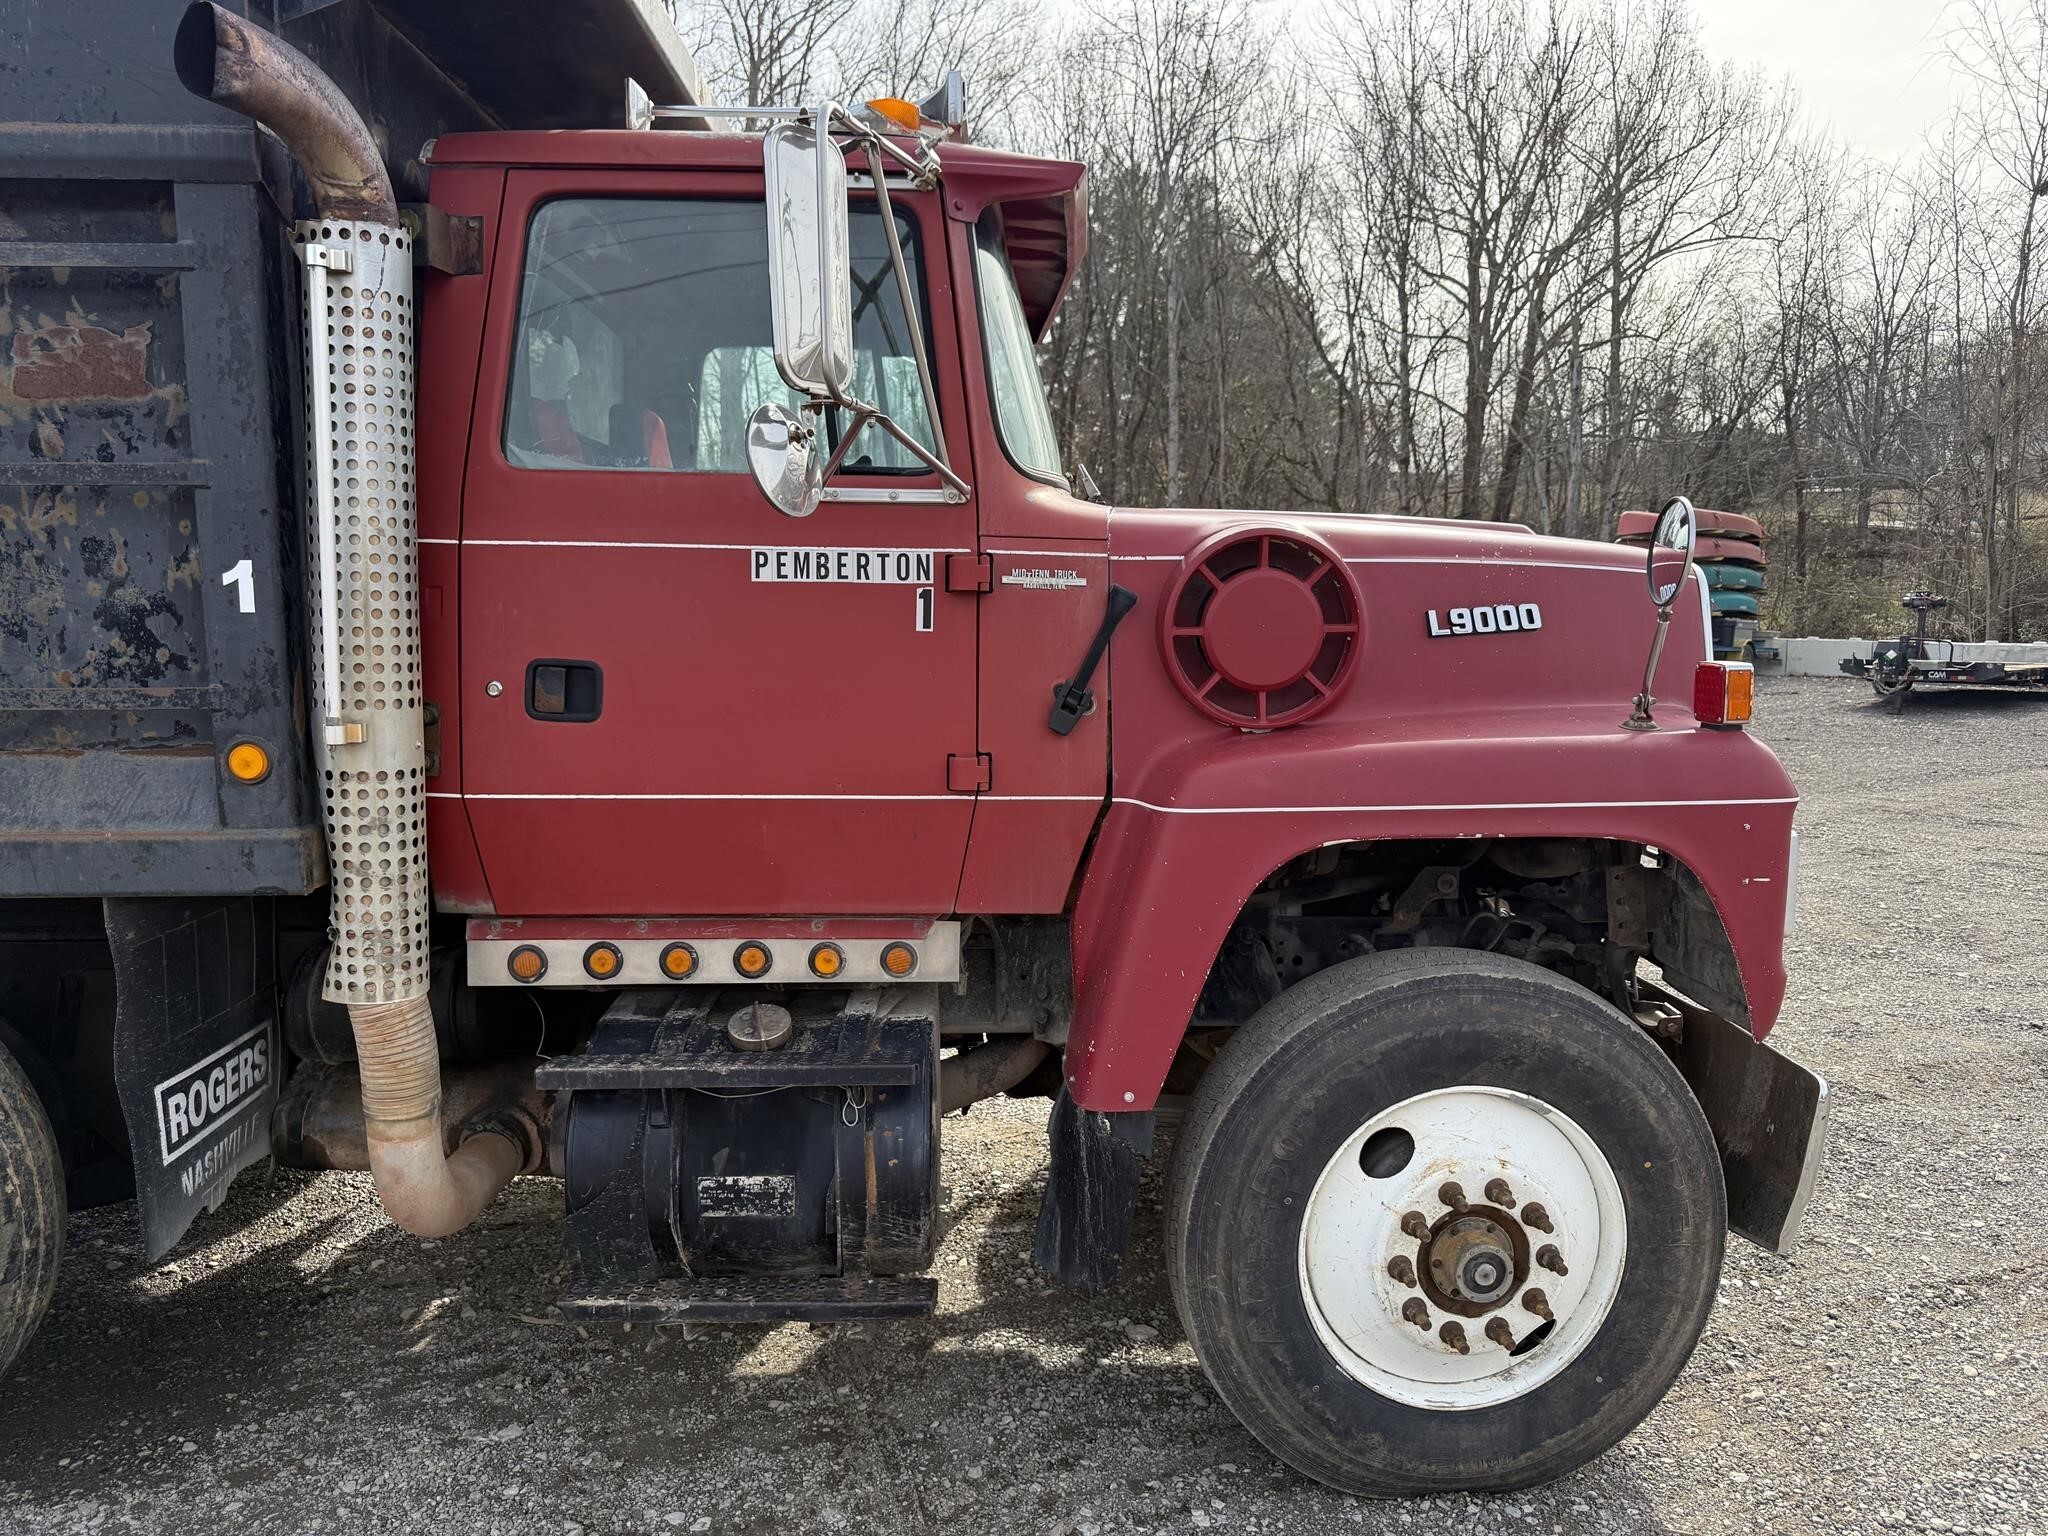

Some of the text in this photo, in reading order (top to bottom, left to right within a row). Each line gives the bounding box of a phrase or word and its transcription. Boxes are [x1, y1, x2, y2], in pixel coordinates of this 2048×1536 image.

[754, 551, 931, 581] PEMBERTON
[1054, 569, 1078, 580] TRUCK
[222, 559, 256, 613] 1
[918, 588, 932, 630] 1
[1426, 603, 1543, 638] L9000
[1928, 671, 1947, 679] CAM
[167, 1038, 268, 1144] ROGERS
